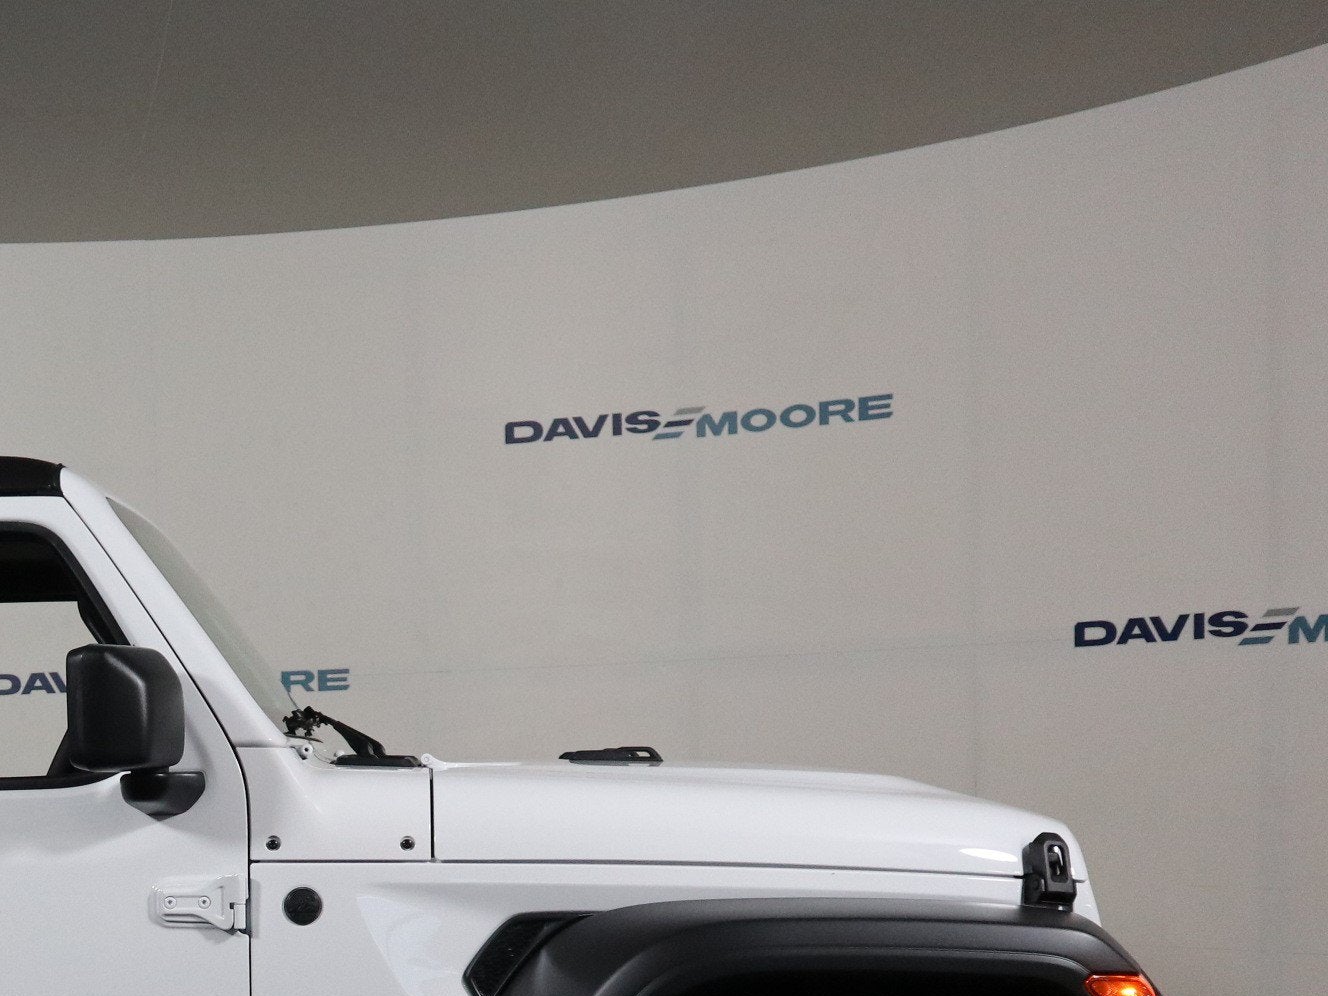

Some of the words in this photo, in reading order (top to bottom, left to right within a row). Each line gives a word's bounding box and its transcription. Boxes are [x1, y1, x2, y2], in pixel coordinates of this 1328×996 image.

[504, 410, 661, 445] DAVIS
[696, 393, 894, 438] MOORE
[1074, 610, 1249, 648] DAVIS
